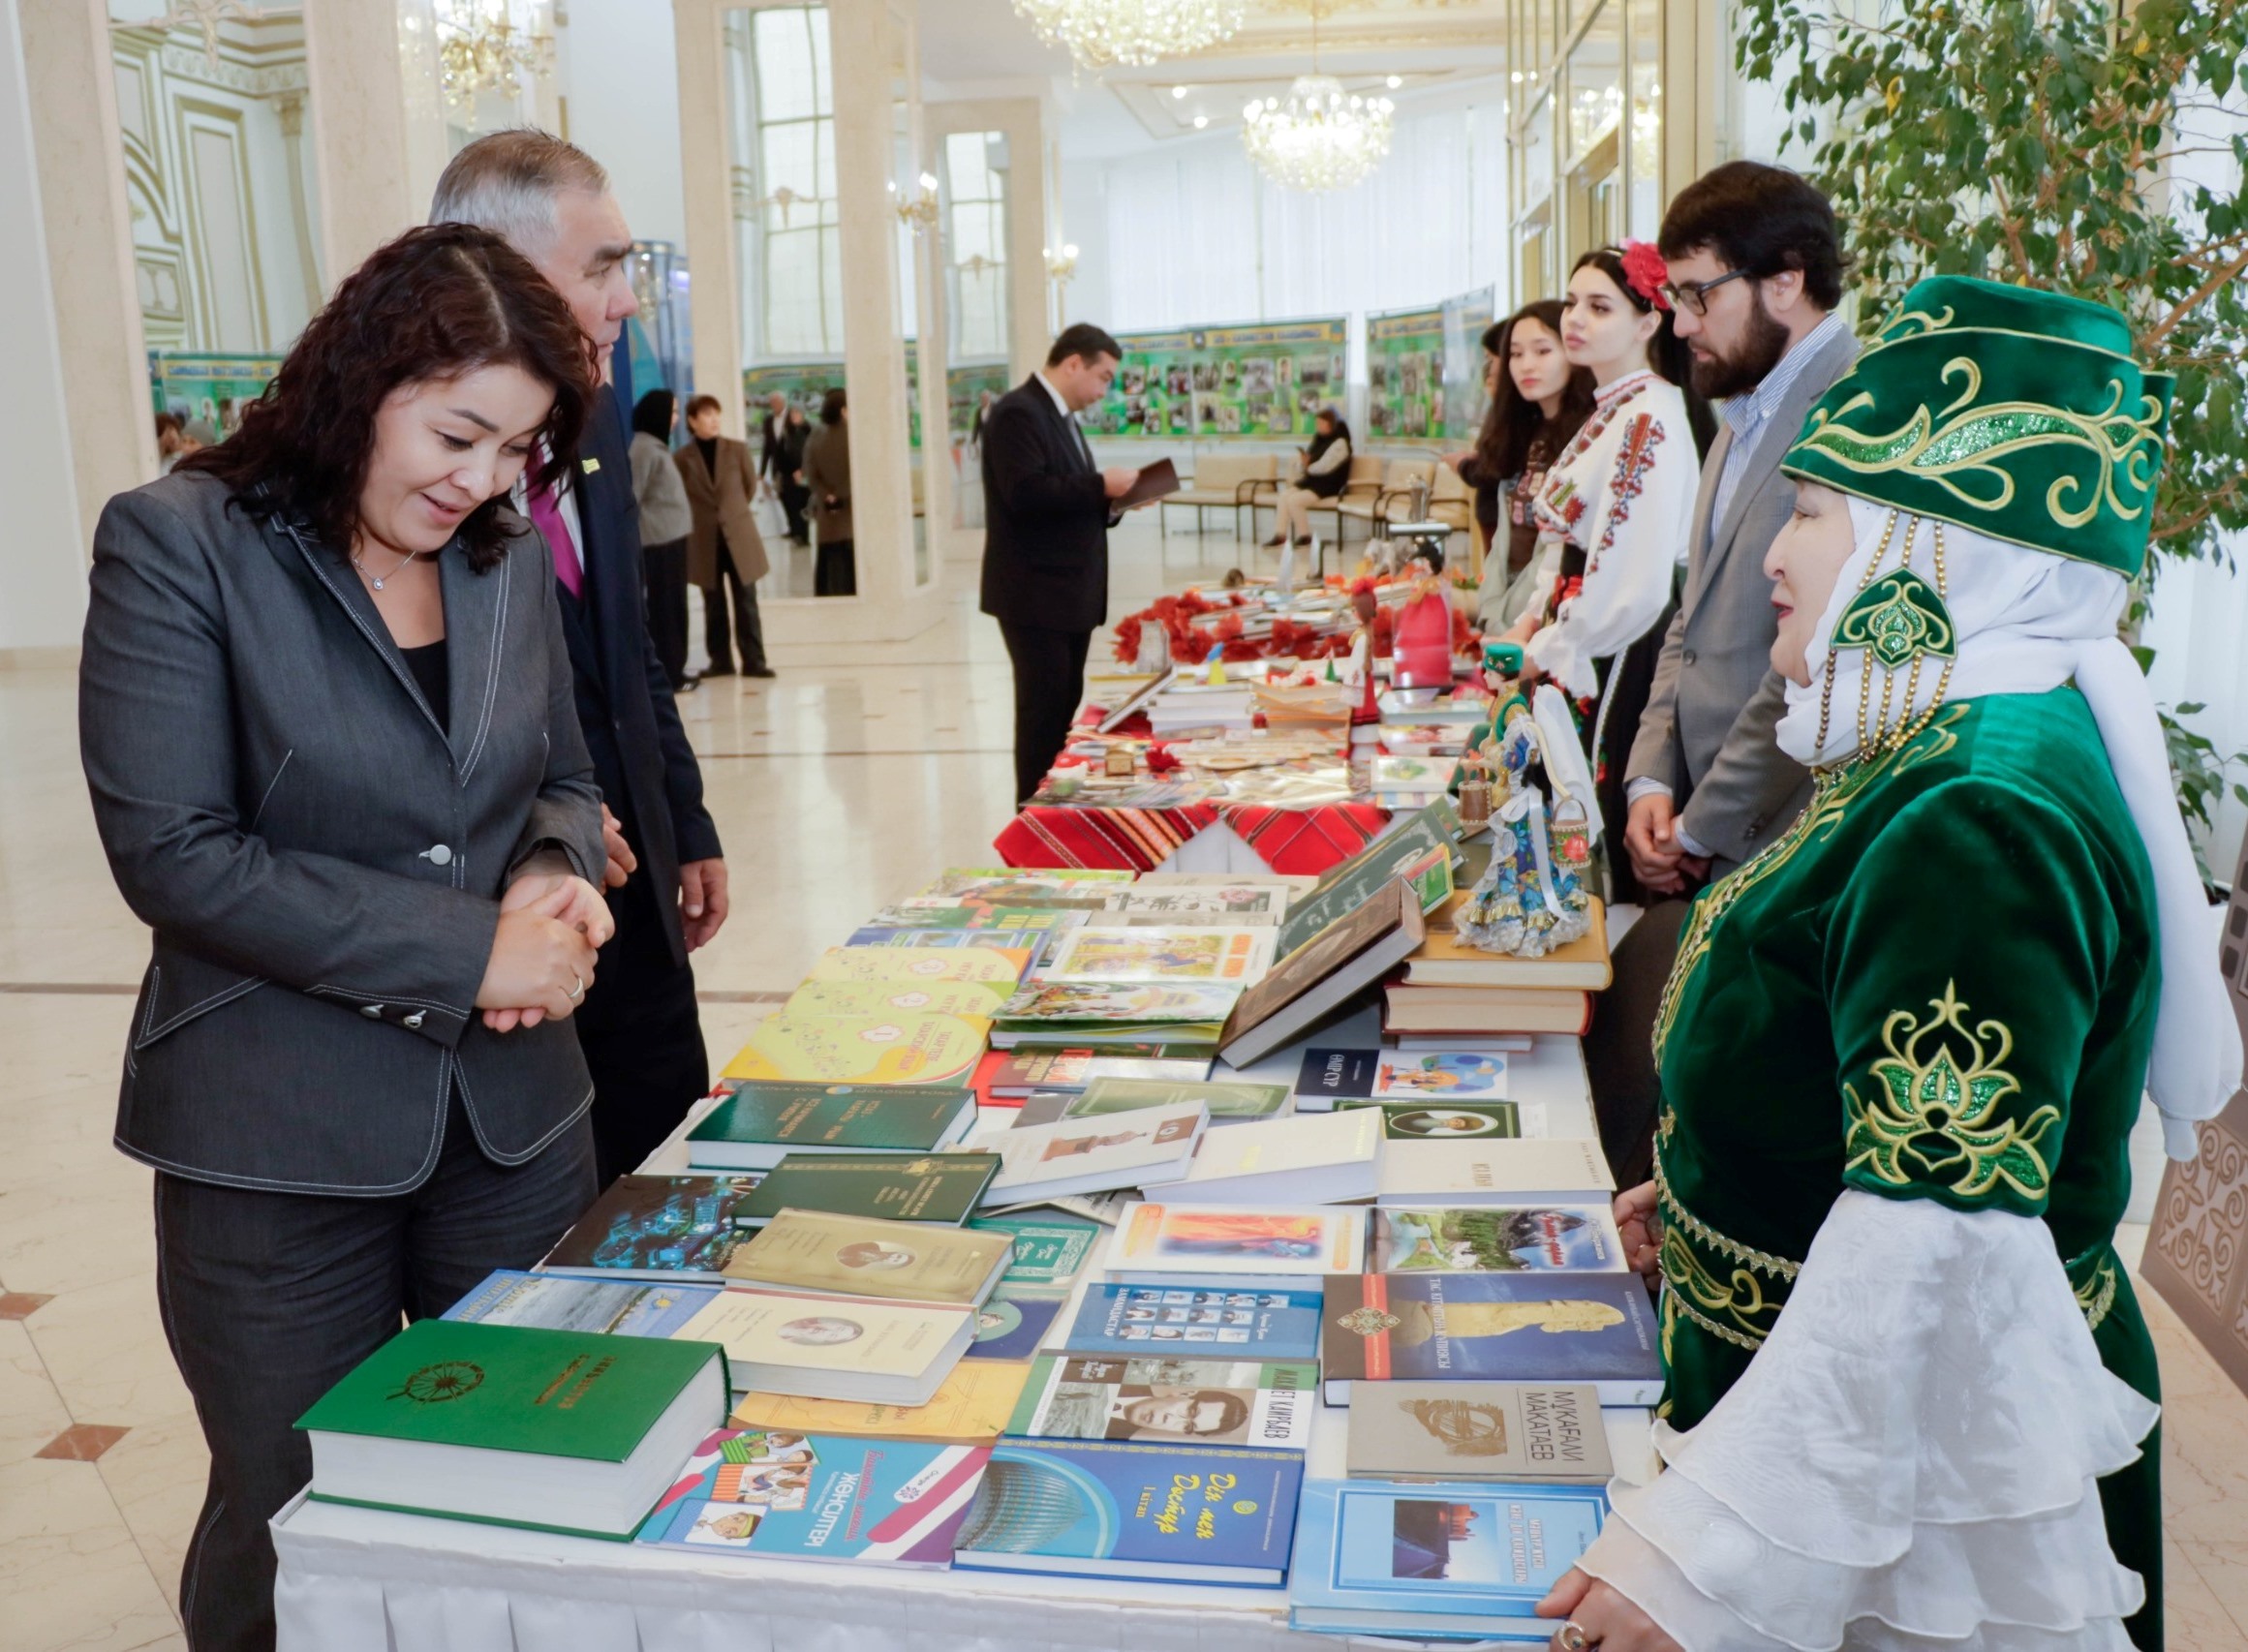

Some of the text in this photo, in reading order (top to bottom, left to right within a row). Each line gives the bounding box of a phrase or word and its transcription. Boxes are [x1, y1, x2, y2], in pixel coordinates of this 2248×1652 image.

[1103, 1287, 1128, 1335] ЗАМАНДАСТАР
[1430, 1278, 1440, 1291] ТАС
[1526, 1392, 1554, 1460] МАҚАТАЕВ
[1552, 1391, 1584, 1461] МҰҚАҒАЛИ
[804, 1471, 858, 1546] ЖӨНСІЛТЕРІ
[1135, 1492, 1153, 1517] кітап
[1196, 1474, 1236, 1540] Дін мен
